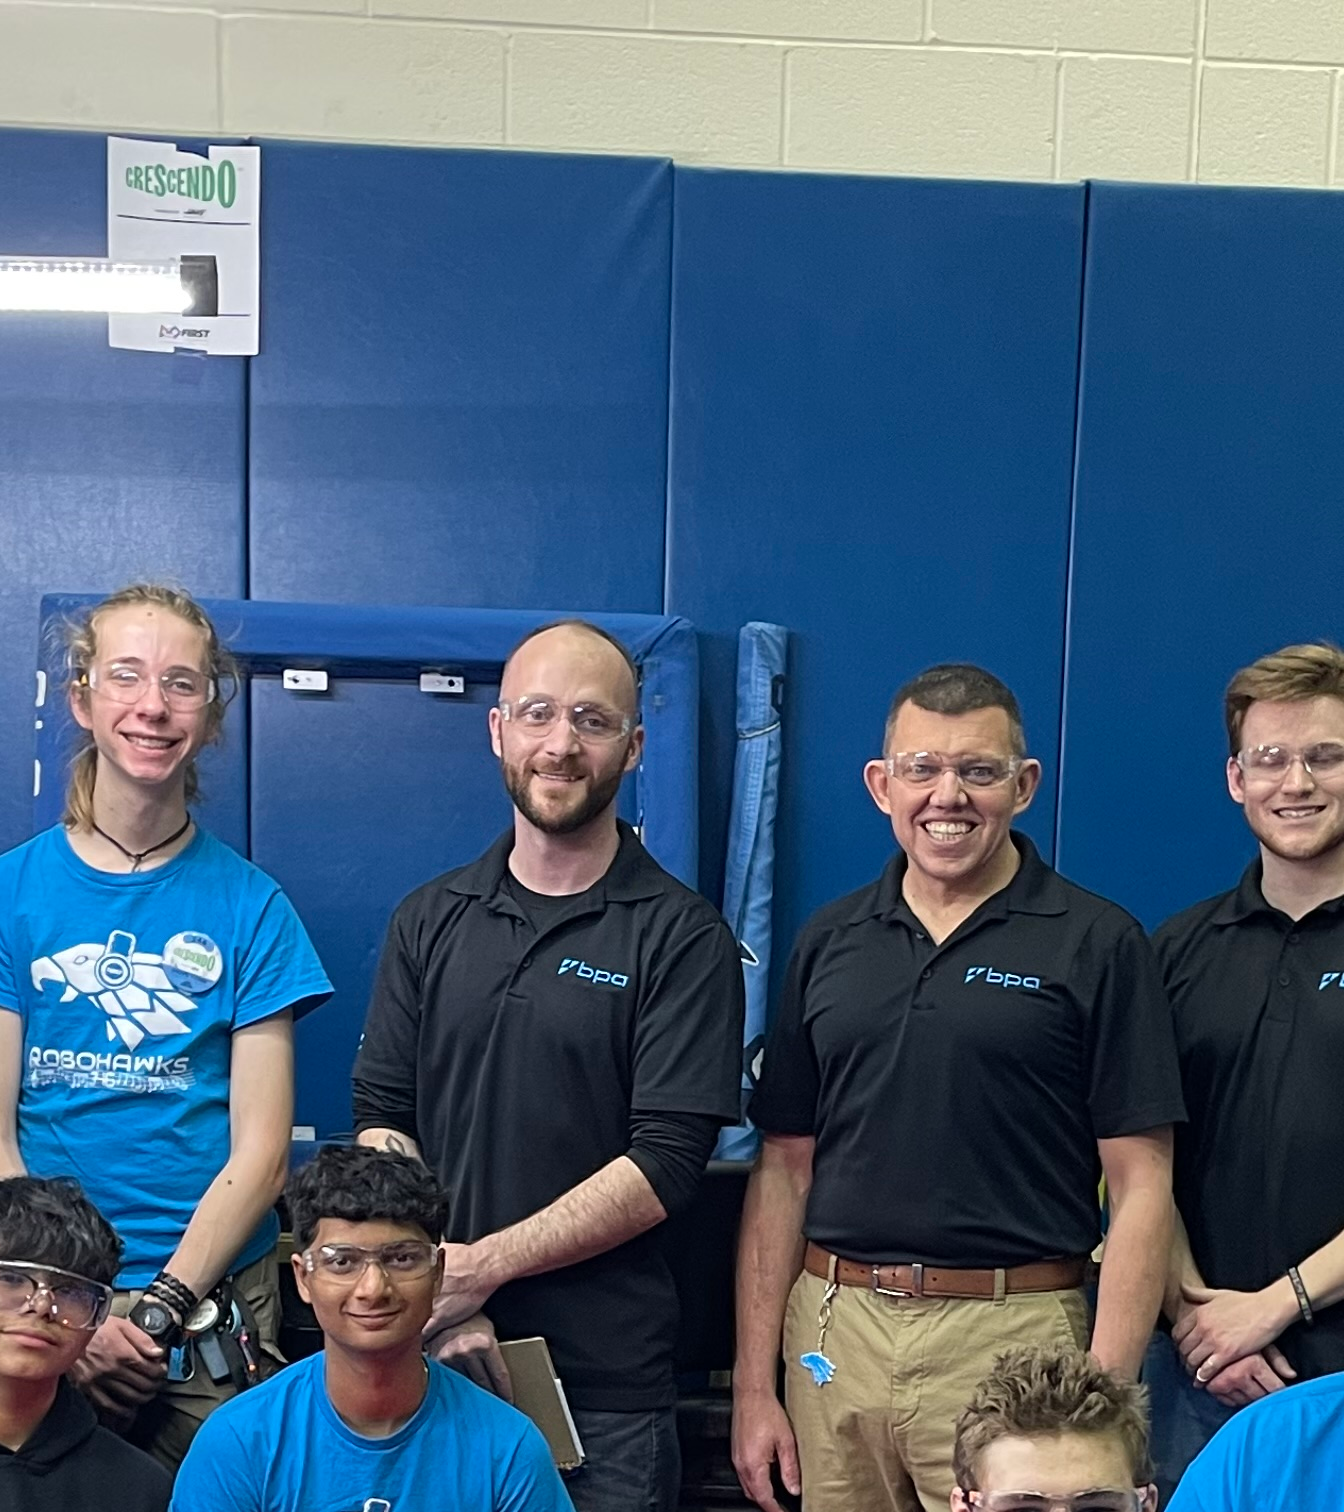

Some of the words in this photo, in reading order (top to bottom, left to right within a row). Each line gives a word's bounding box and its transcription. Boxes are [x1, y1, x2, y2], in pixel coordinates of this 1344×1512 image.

[125, 159, 236, 208] CRESCENDO
[576, 961, 629, 987] bpa
[986, 967, 1040, 989] bpa
[29, 1046, 190, 1075] ROBOHAWKS
